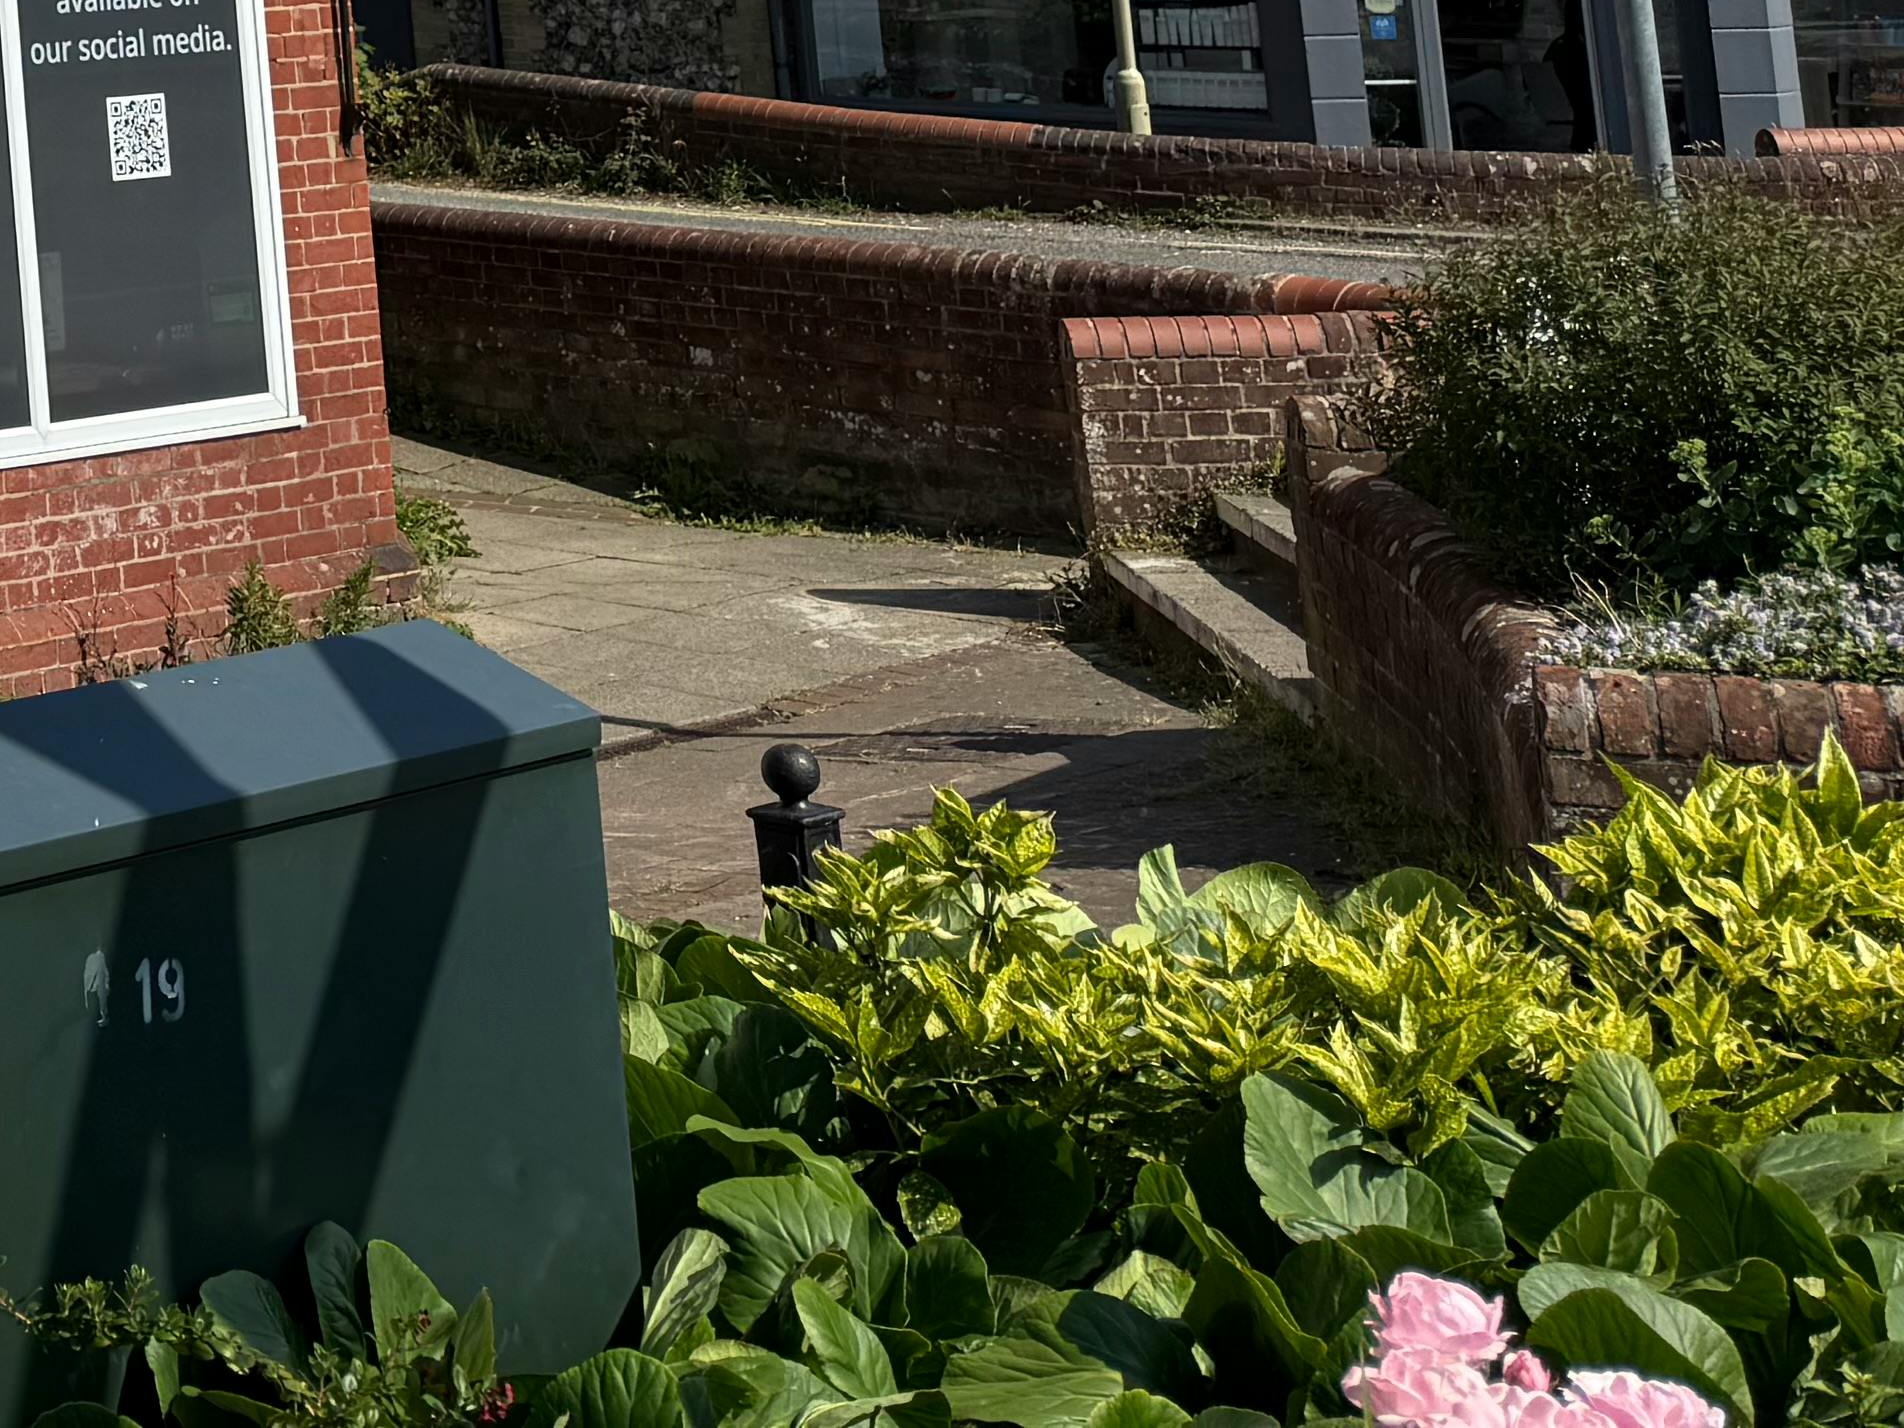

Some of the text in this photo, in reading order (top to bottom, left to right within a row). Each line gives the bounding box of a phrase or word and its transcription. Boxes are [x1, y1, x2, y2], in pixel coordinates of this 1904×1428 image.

[30, 24, 232, 65] our social media.
[135, 957, 185, 1024] 19
